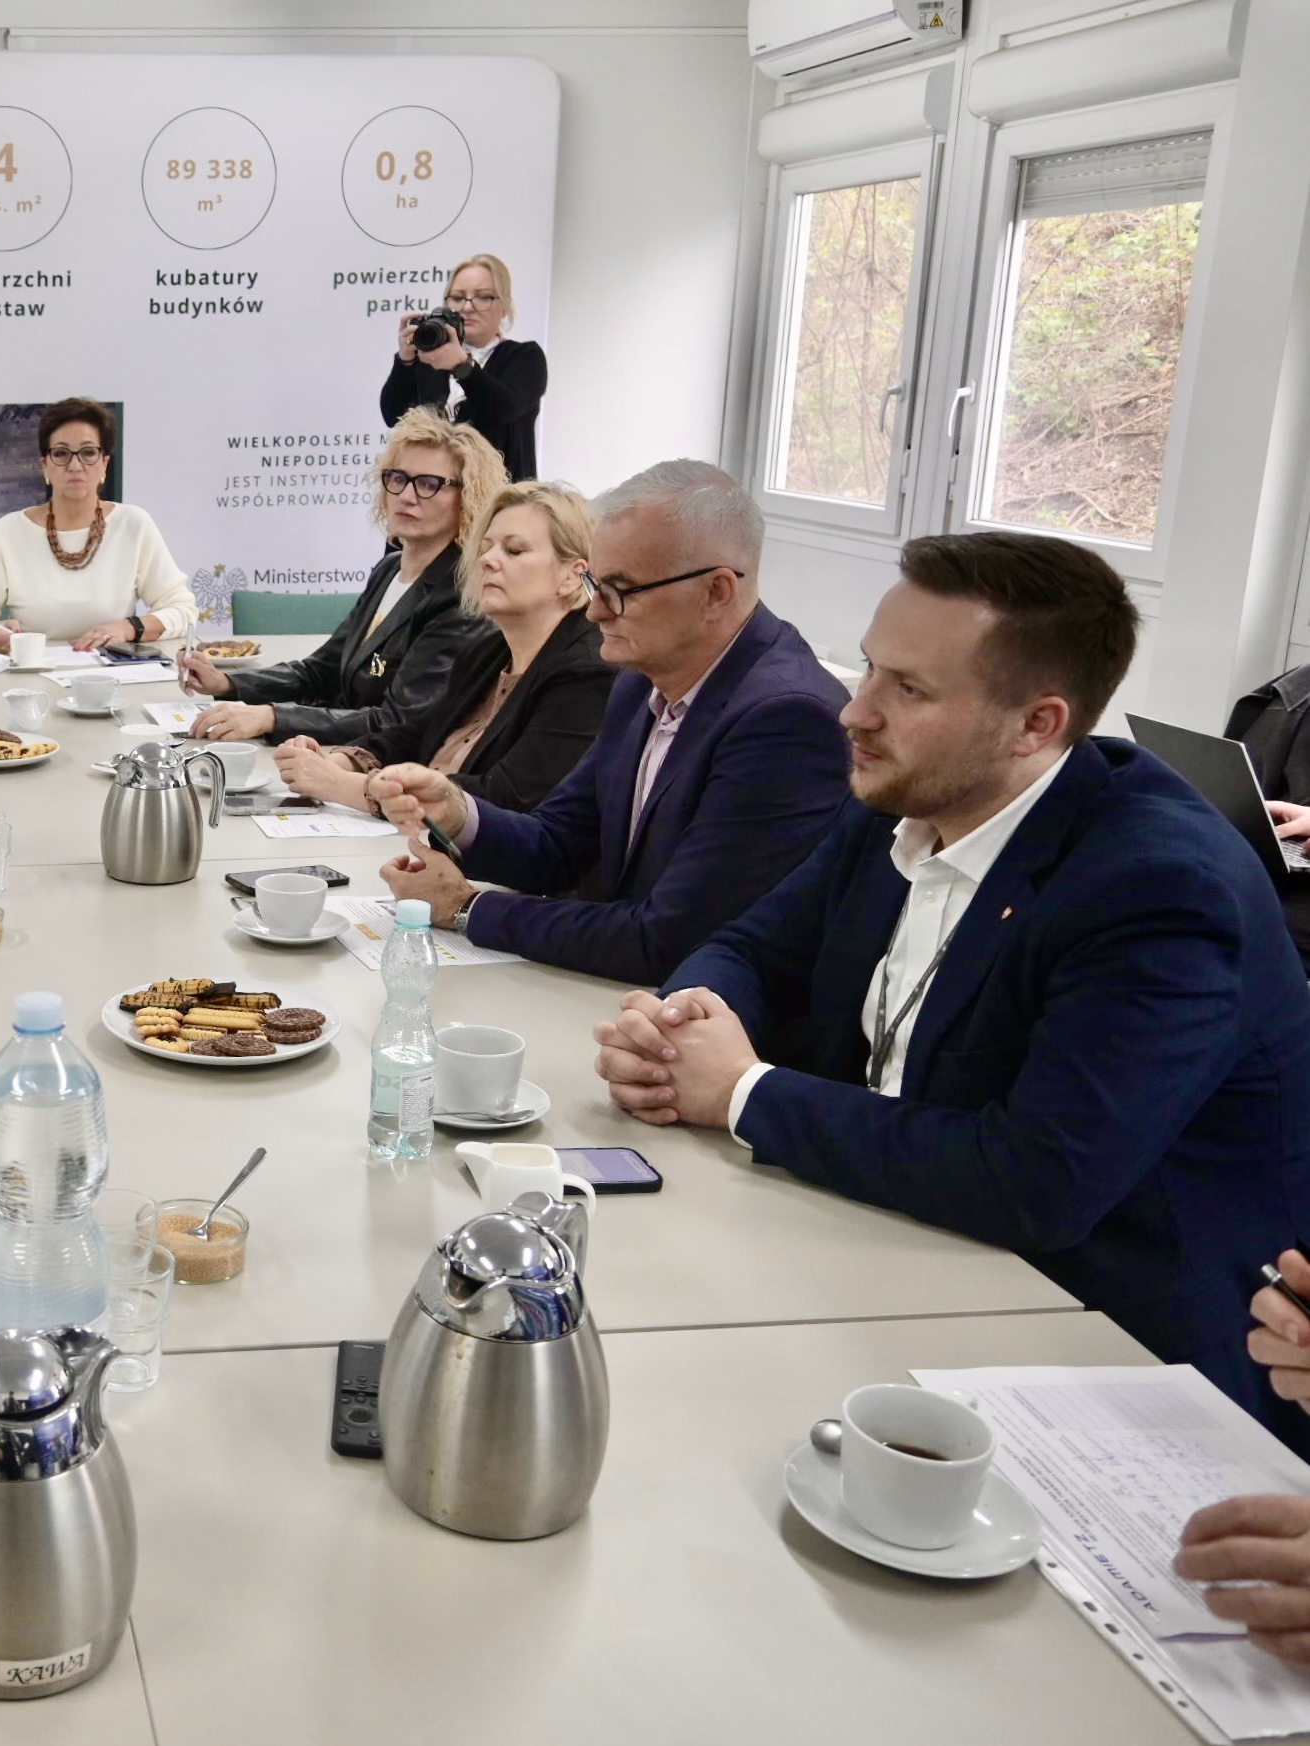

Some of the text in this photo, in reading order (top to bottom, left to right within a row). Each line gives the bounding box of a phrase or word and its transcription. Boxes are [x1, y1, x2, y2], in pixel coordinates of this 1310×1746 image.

[167, 160, 252, 179] 89 338
[376, 151, 432, 185] 0,8
[397, 194, 418, 208] ha
[157, 269, 258, 289] kubatury
[150, 297, 263, 318] budynków
[366, 295, 429, 316] parku
[228, 435, 369, 448] WIELKOPOLSKIE
[262, 454, 378, 468] NIEPODLEGŁ
[225, 476, 261, 491] JEST
[216, 493, 372, 508] WSPÓŁPROWADZO
[254, 569, 365, 584] Ministerstwo
[7, 1654, 84, 1685] KAWA
